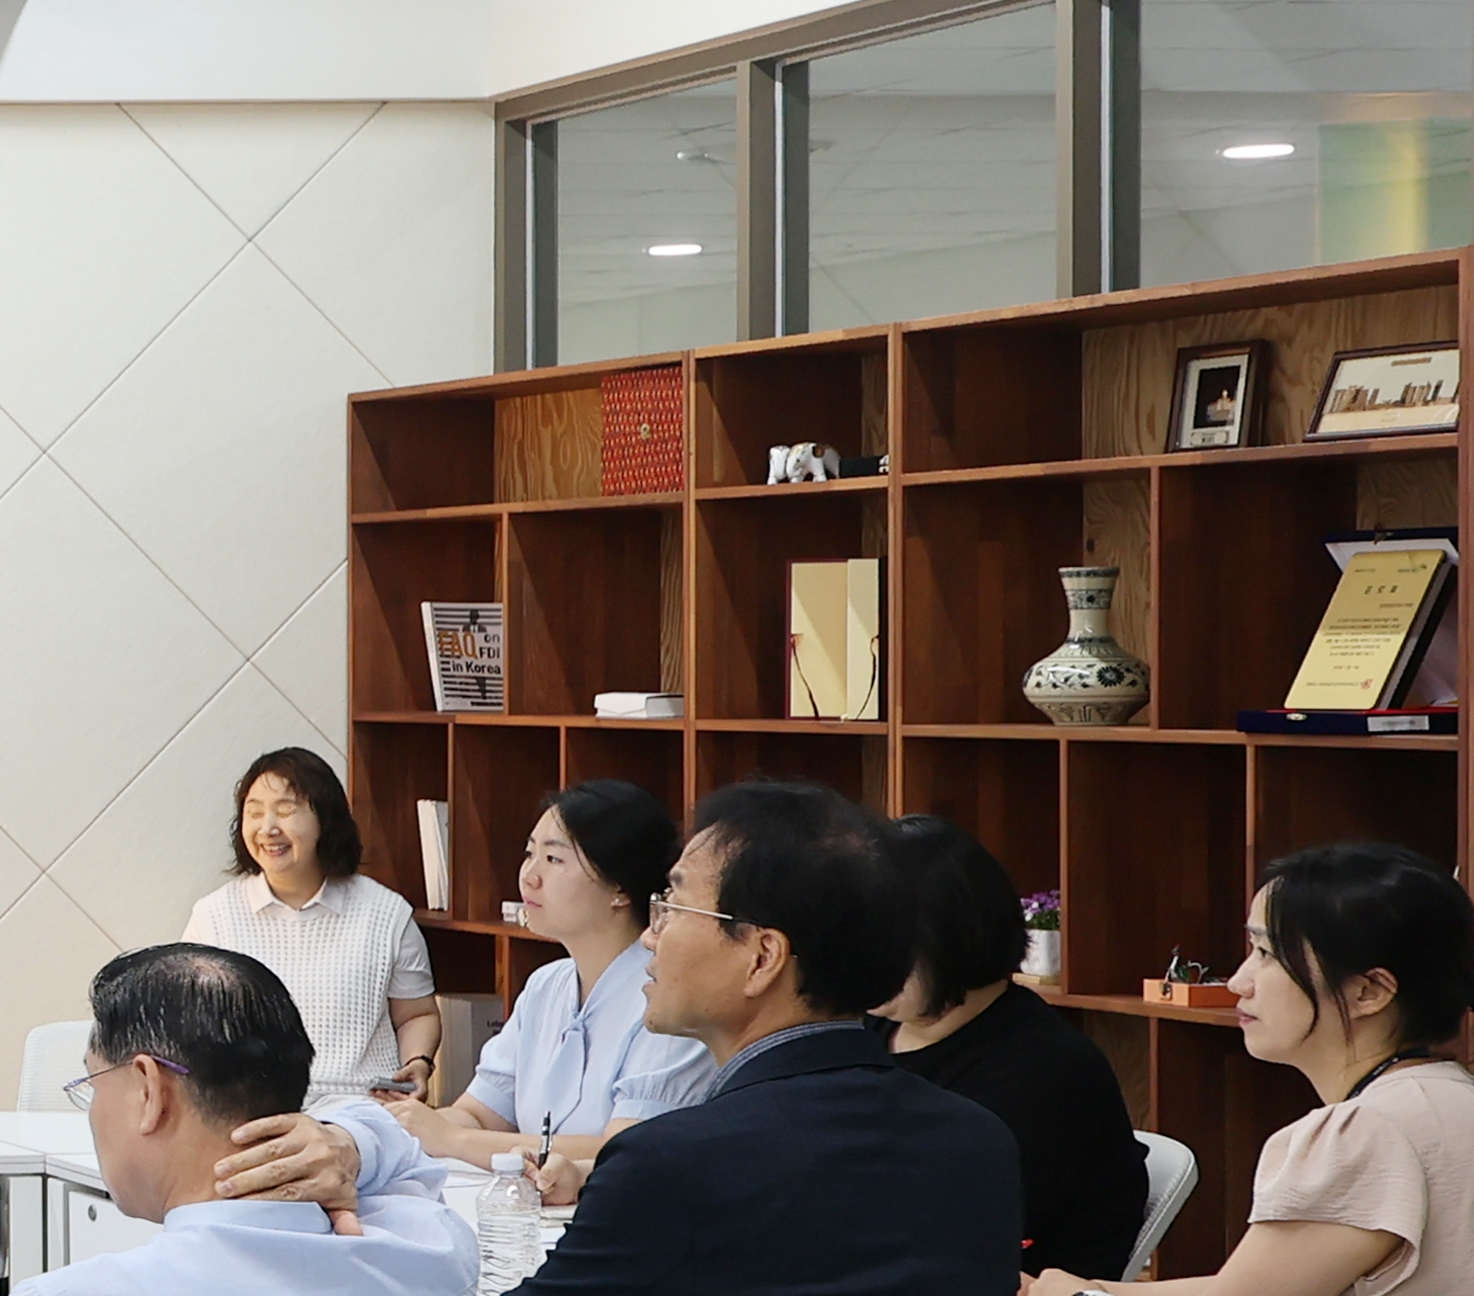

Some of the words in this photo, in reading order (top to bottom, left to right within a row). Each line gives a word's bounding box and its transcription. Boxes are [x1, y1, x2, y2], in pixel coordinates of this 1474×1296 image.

[437, 632, 478, 660] FAQ
[484, 633, 500, 643] on
[452, 660, 463, 673] in
[466, 661, 501, 674] Korea
